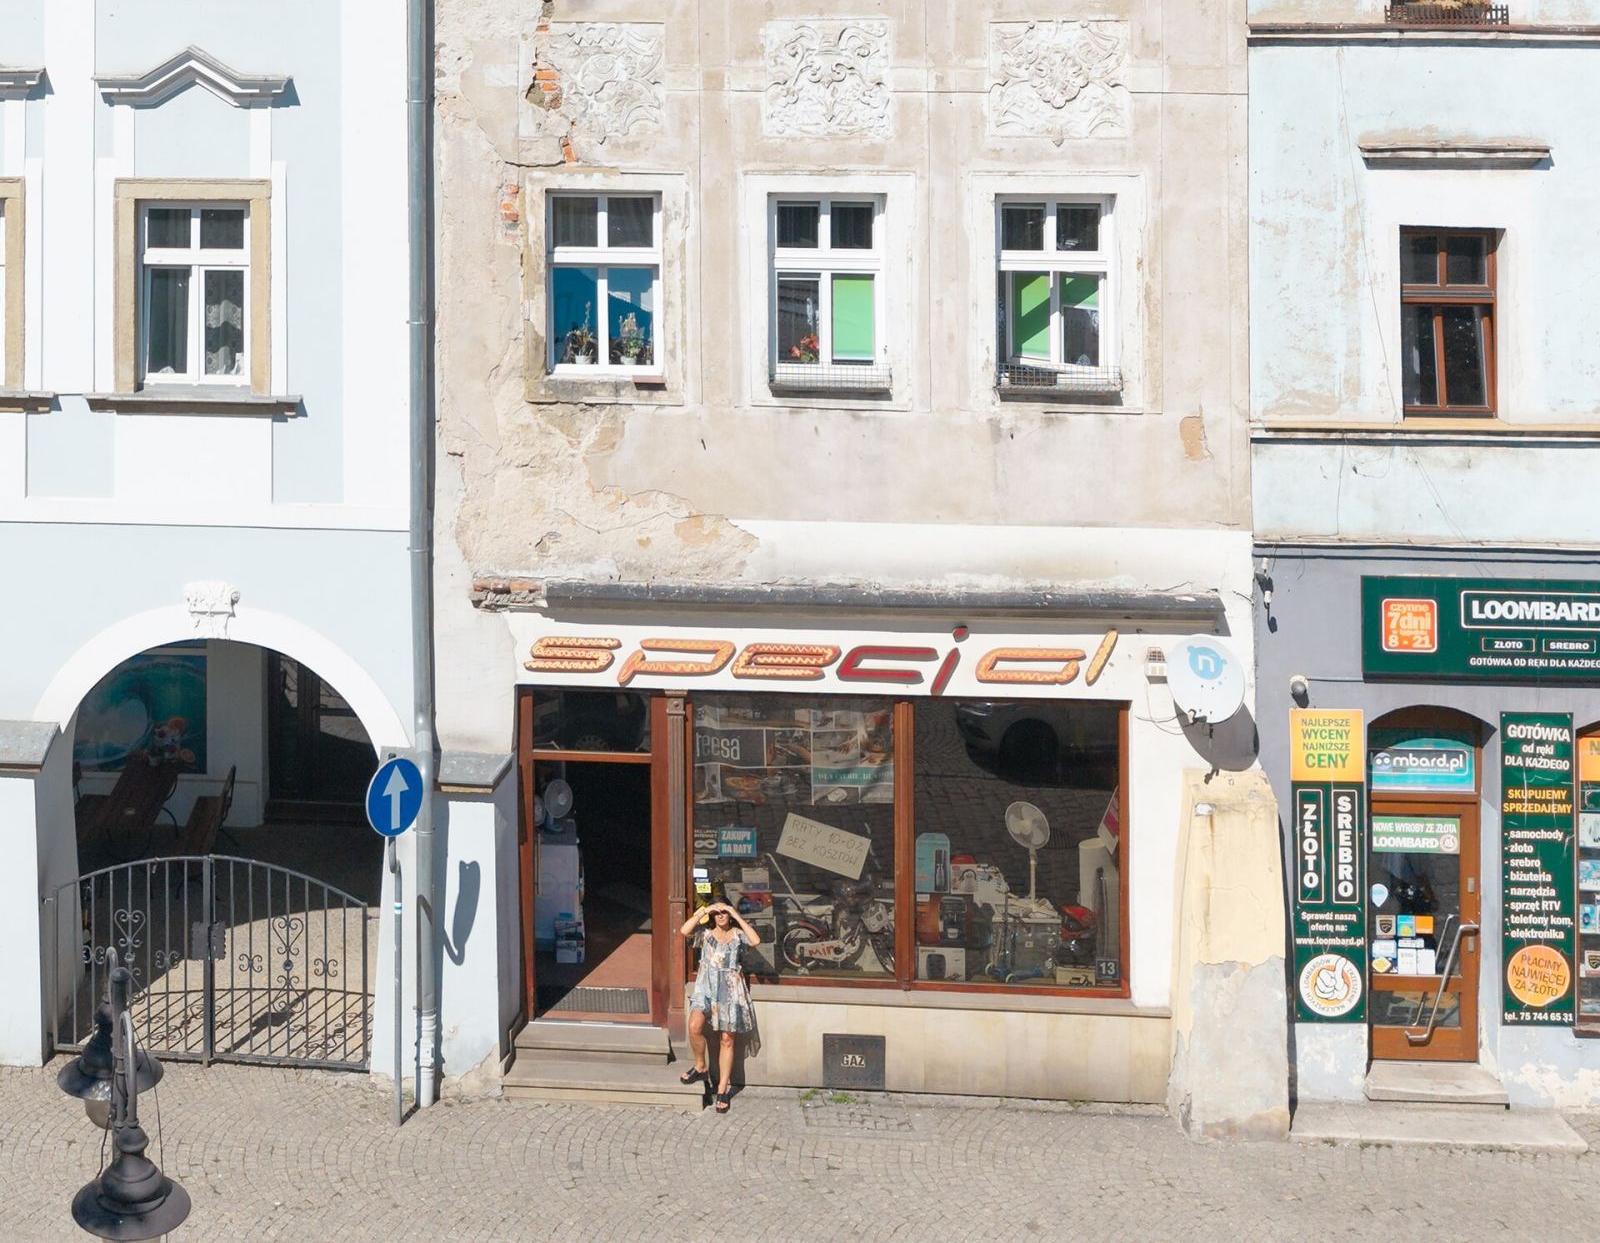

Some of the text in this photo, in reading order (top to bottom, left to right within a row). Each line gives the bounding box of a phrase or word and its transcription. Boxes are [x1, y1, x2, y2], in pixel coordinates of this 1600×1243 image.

[1389, 603, 1429, 614] czynne
[1471, 600, 1600, 622] LOOMBARD
[1388, 634, 1399, 648] 8
[1412, 635, 1433, 648] 21
[1494, 640, 1590, 651] ZŁOTO SREBRO
[523, 627, 1118, 696] special
[1469, 655, 1513, 667] GOTÓWKA
[1513, 658, 1527, 667] OD
[1527, 658, 1548, 669] RĘKI
[1549, 659, 1567, 668] DLA
[1301, 718, 1351, 727] NAJLEPSZE
[1301, 729, 1351, 740] WYCENY
[1507, 723, 1571, 742] GOTÓWKA
[1302, 741, 1350, 751] NAJNIŻSZE
[1522, 743, 1554, 756] od ręki
[1305, 753, 1349, 769] CENY
[1504, 755, 1570, 770] DLA KAŻDEGO
[1507, 788, 1567, 799] SKUPUJEMY
[1503, 803, 1572, 814] SPRZEDAJEMY
[1372, 821, 1395, 832] NOWE
[1395, 822, 1425, 833] WYROBY
[1425, 823, 1435, 833] ZE
[721, 830, 752, 841] ZAKUPY
[1509, 829, 1563, 841] samochody
[733, 843, 753, 854] RATY
[1302, 803, 1319, 889] ZŁOTO
[1337, 795, 1354, 898] SREBRO
[1372, 836, 1439, 849] LOOMBARD
[1509, 843, 1534, 853] złoto
[1509, 857, 1541, 867] srebro
[1509, 871, 1552, 882] biżuteria
[1510, 886, 1556, 898] narzędzia
[1510, 901, 1540, 912] sprzęt
[1541, 900, 1561, 911] RTV
[1301, 911, 1357, 922] Sprawdź naszą
[1510, 914, 1549, 926] telefony
[1550, 915, 1573, 925] kom.
[1310, 923, 1348, 932] ofertę na:
[1510, 928, 1565, 939] elektronika
[1295, 937, 1364, 947] www.loombard.pl
[1100, 962, 1116, 975] 13
[1520, 954, 1562, 971] PŁACIMY
[1511, 965, 1567, 986] NAJWIĘCEJ
[1514, 979, 1559, 997] ZA ZŁOTO
[1520, 1012, 1531, 1021] 75
[1533, 1012, 1549, 1021] 744
[1550, 1013, 1561, 1021] 65
[1562, 1013, 1573, 1022] 31
[841, 1054, 865, 1067] GAZ
